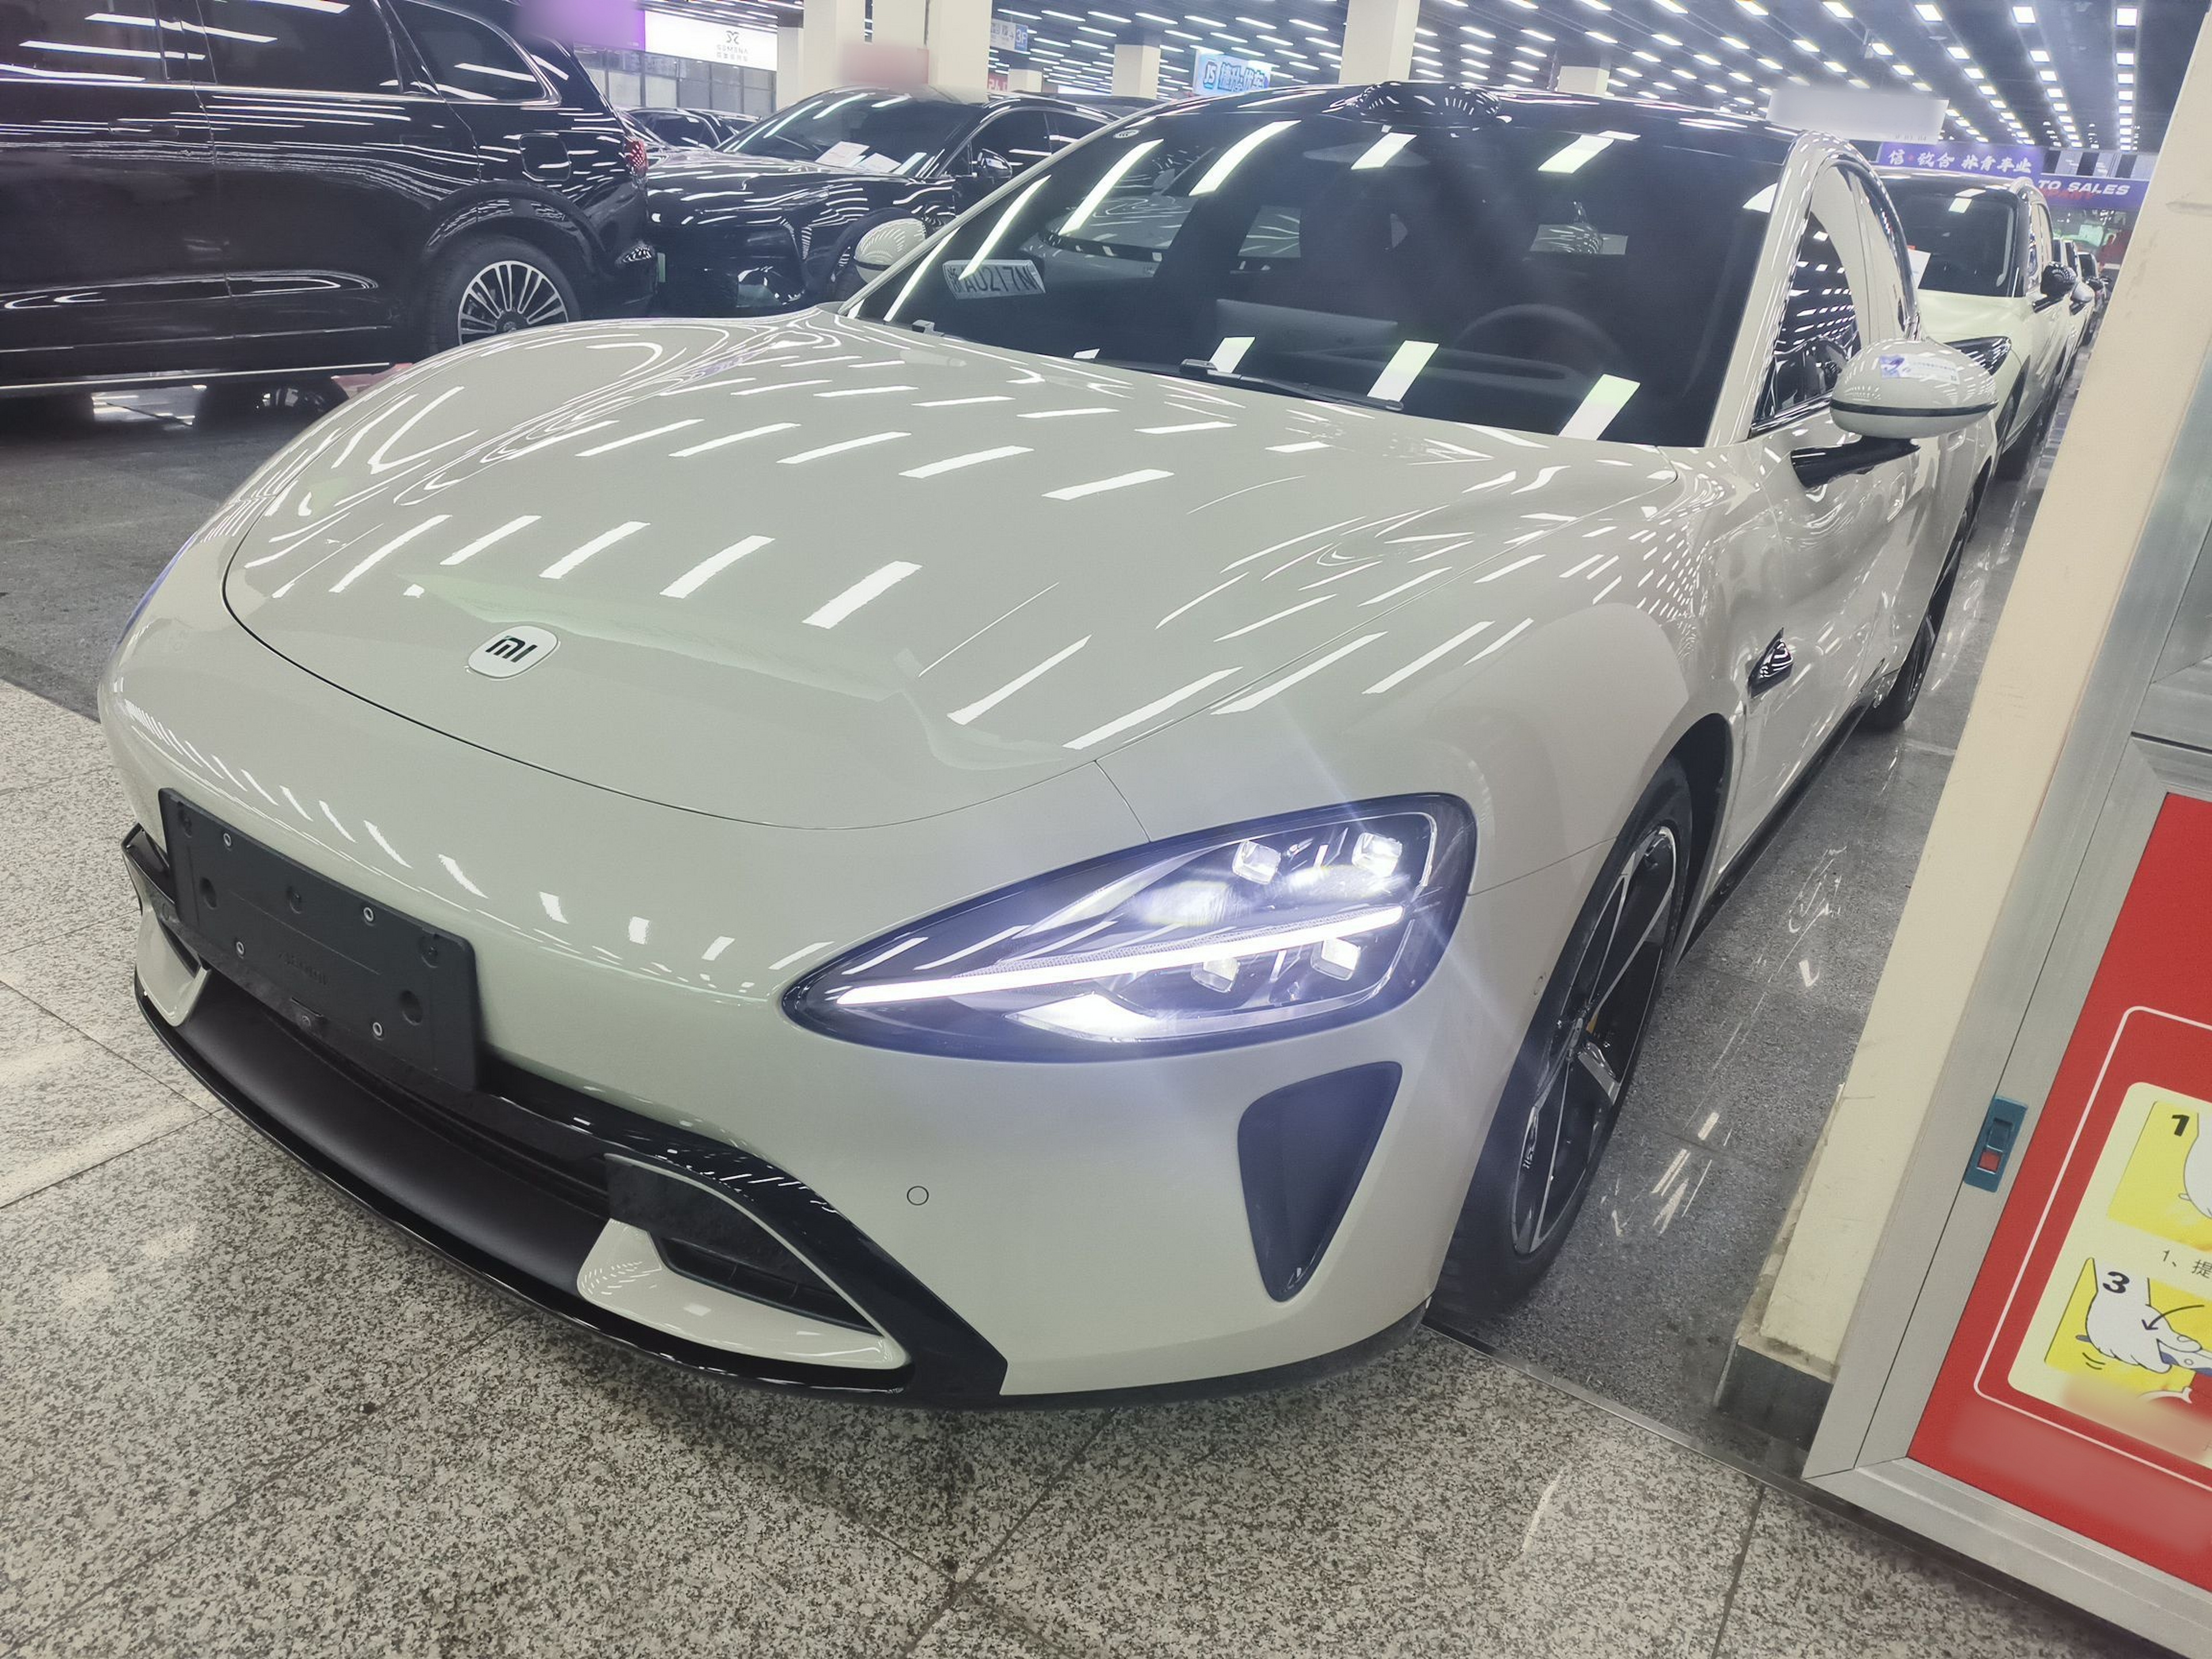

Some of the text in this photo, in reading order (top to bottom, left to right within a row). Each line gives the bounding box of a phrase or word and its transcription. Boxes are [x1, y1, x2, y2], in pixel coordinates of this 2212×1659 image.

[2068, 182, 2130, 195] SALES
[2171, 1114, 2190, 1137] 1
[2103, 1271, 2130, 1294] 3
